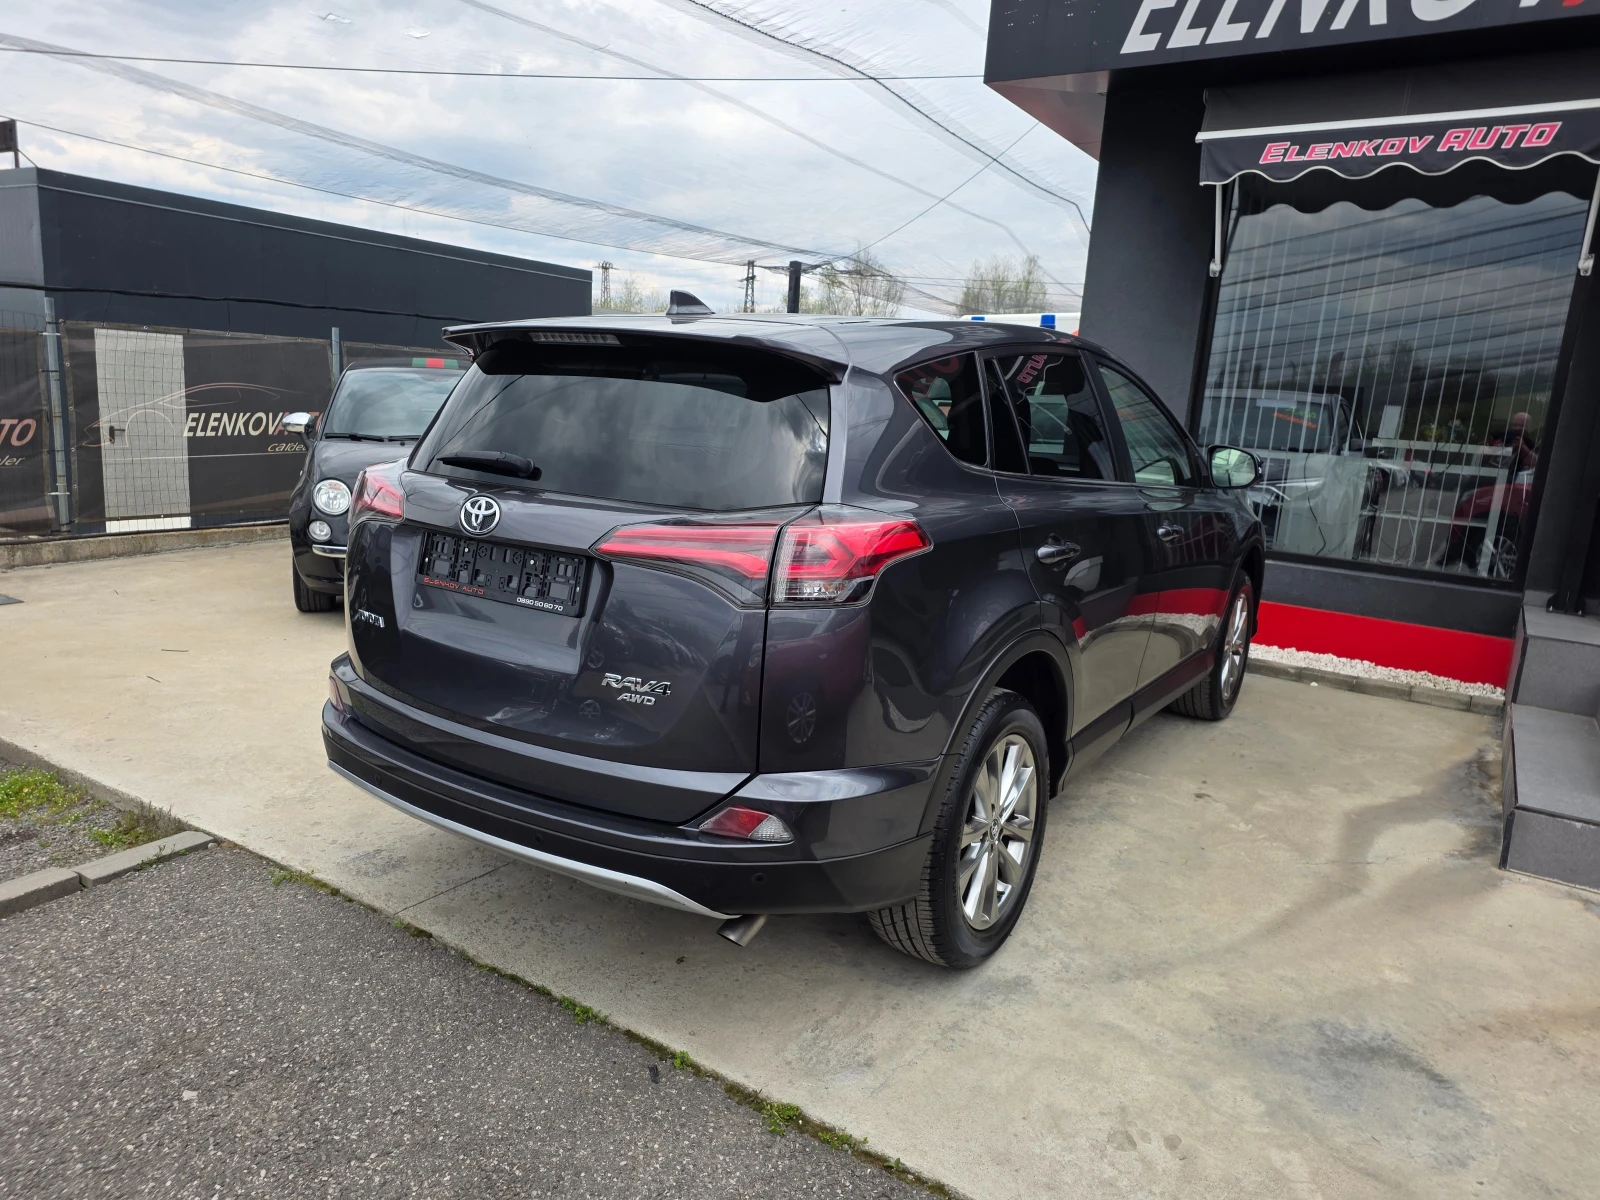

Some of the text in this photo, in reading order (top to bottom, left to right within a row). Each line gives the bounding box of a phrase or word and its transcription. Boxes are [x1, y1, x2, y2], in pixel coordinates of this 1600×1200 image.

[1437, 122, 1563, 152] AUTO
[462, 585, 485, 595] AUTO
[534, 600, 544, 608] 50
[553, 604, 564, 612] 70
[601, 672, 672, 697] RAV4
[617, 692, 656, 706] AWD
